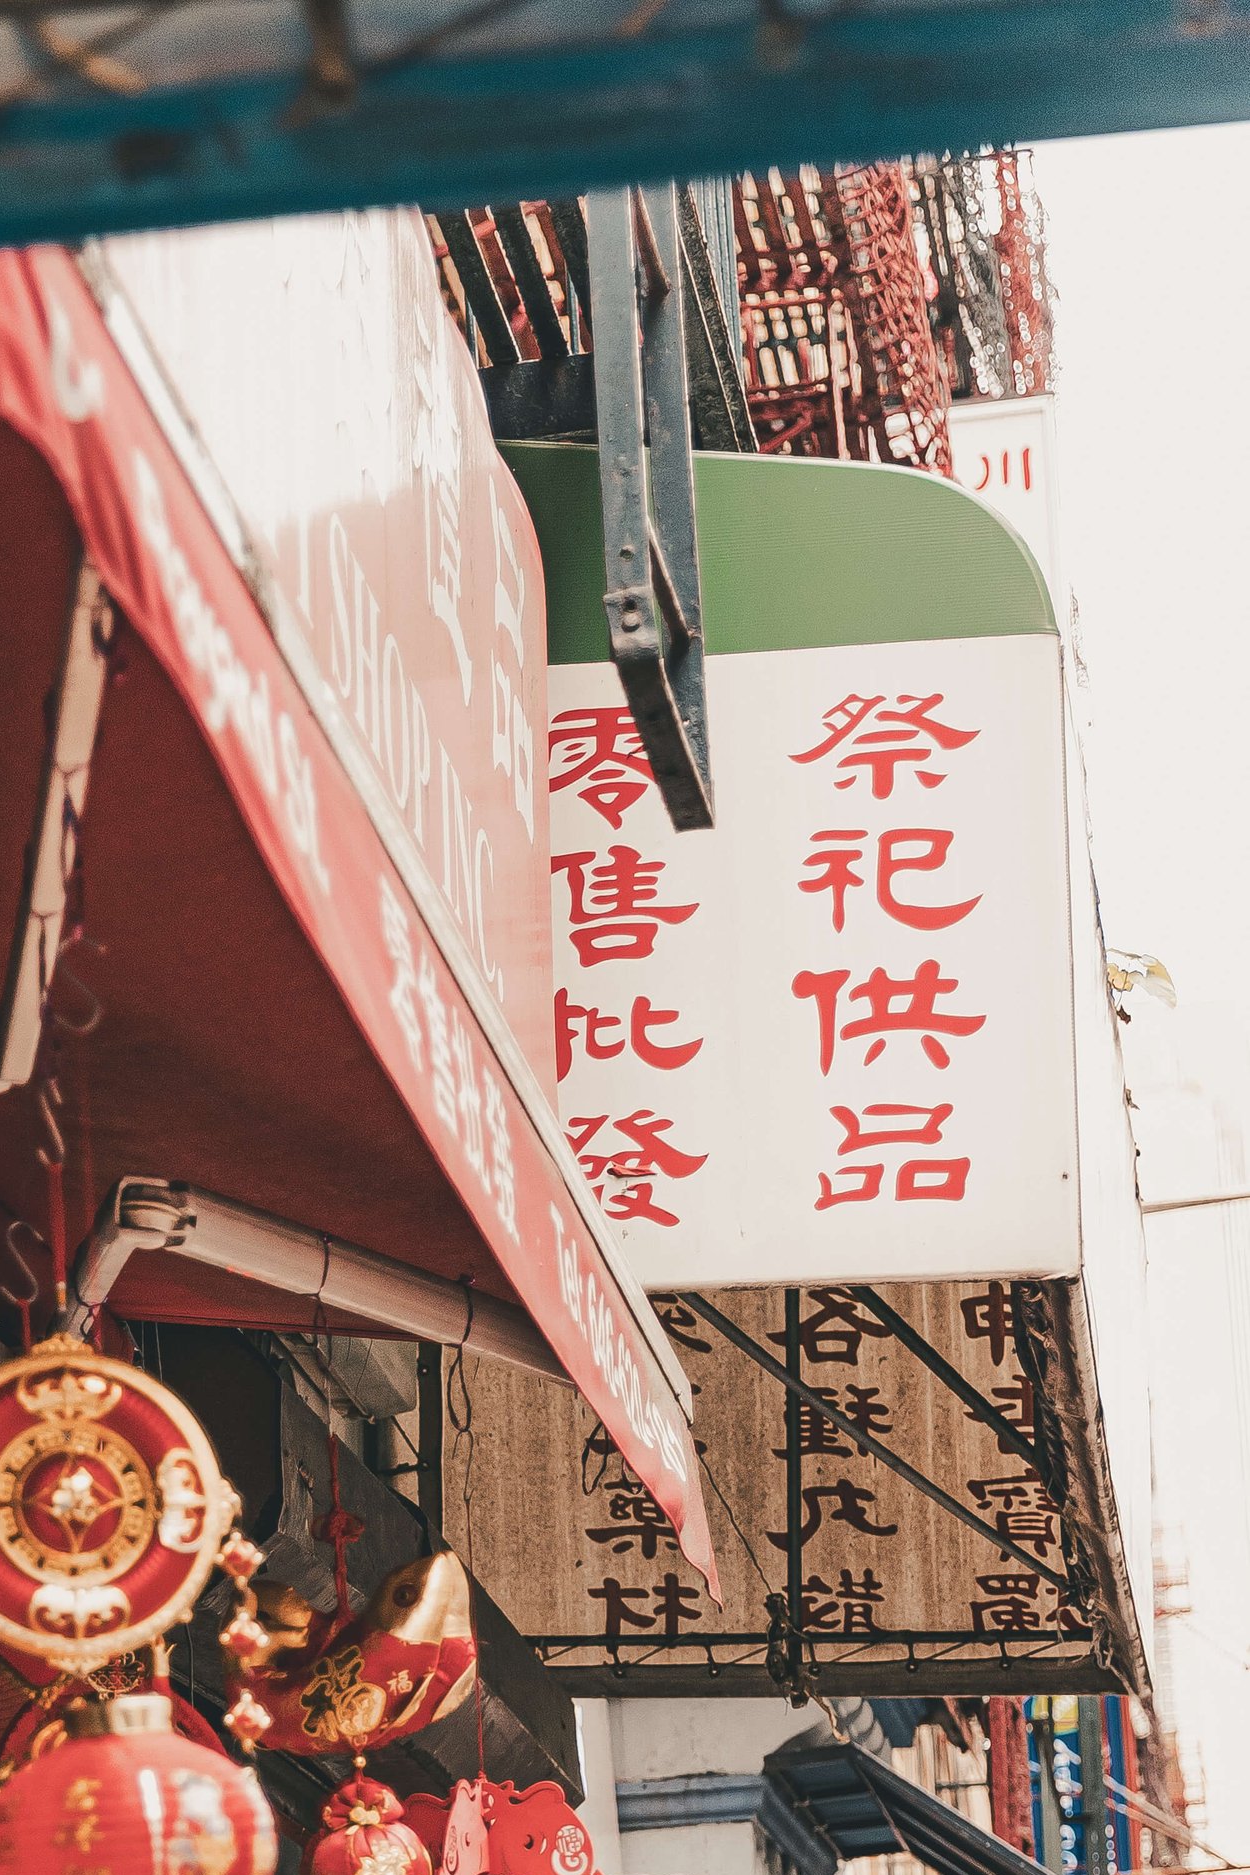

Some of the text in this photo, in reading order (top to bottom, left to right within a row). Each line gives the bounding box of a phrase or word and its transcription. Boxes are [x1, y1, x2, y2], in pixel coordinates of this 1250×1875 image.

[331, 512, 505, 1004] SHOP INC.
[549, 706, 709, 1229] 零售批發
[788, 692, 987, 1213] 祭祀供品
[386, 1669, 413, 1696] 福
